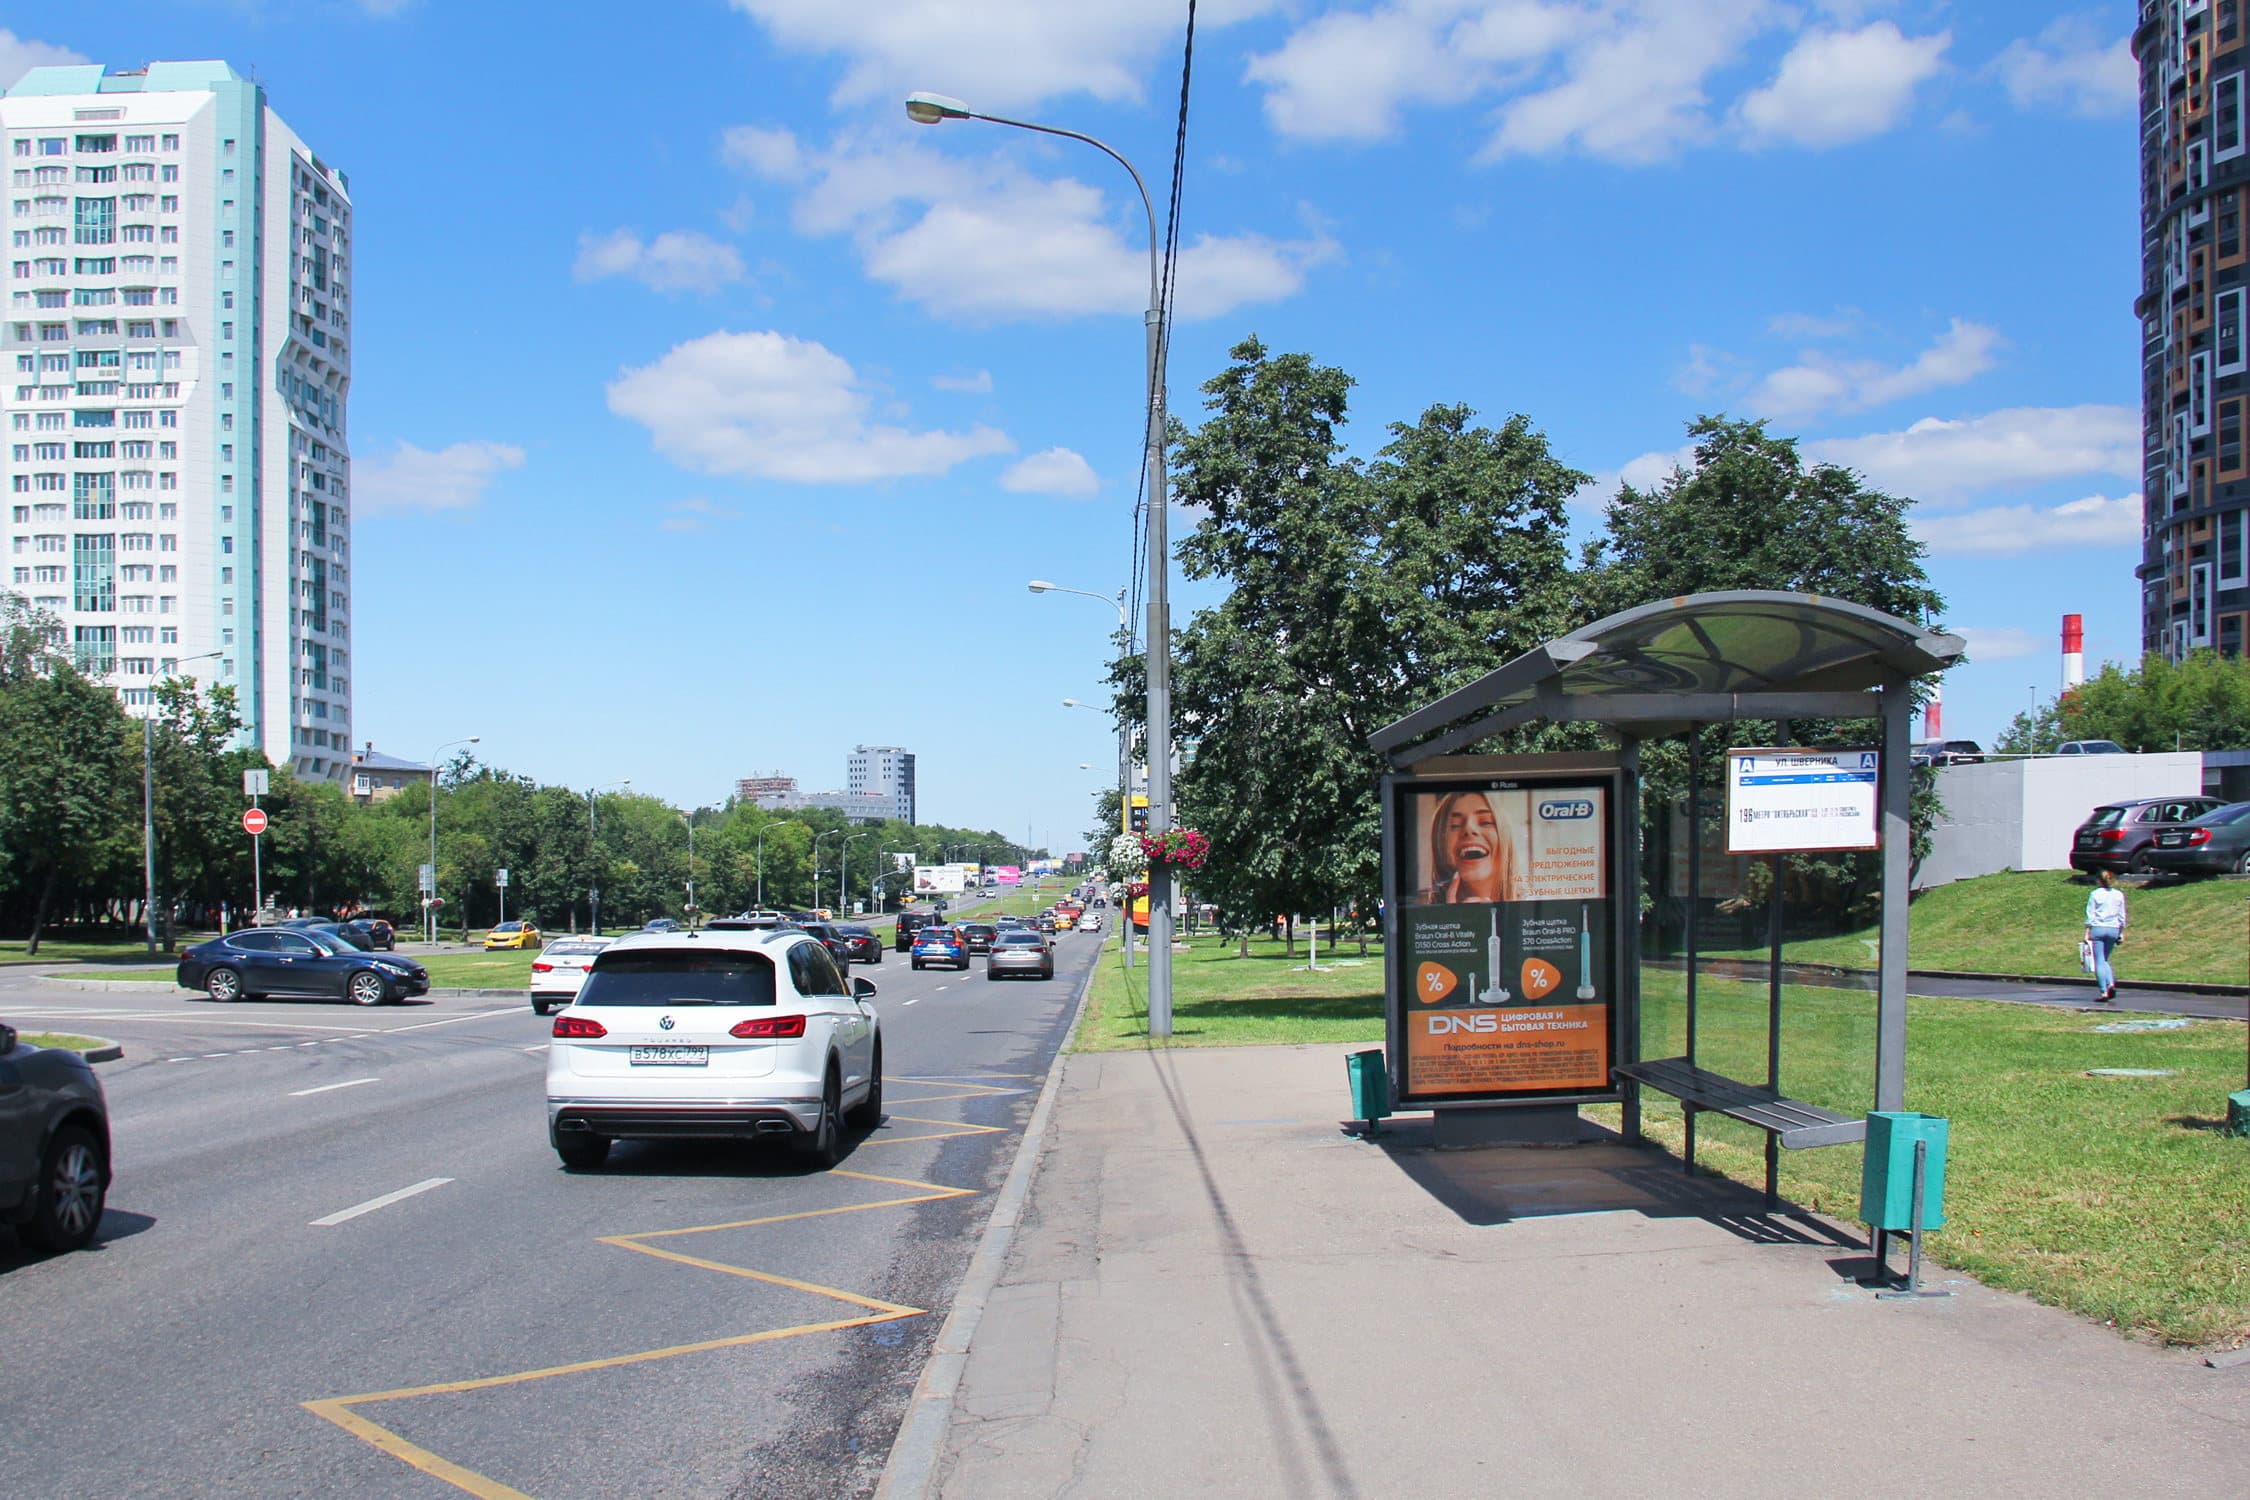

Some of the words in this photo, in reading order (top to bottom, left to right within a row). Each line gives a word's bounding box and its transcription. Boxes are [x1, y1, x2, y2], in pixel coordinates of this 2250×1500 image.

[1790, 756, 1839, 768] ШВЕРНИКА
[1541, 803, 1590, 818] Oral-B
[1739, 808, 1753, 823] 196
[1545, 847, 1595, 856] ВЫГОДНЫЕ
[1528, 860, 1595, 870] ПРЕДЛОЖЕНИЯ
[1526, 873, 1595, 883] ЭЛЕКТРИЧЕСКИЕ
[1529, 887, 1562, 897] ЗУБНЫЕ
[1564, 887, 1595, 895] ЩЕТКИ
[1415, 922, 1438, 931] Зубная
[1522, 919, 1545, 928] Зубная
[1415, 932, 1434, 940] Braun
[1522, 927, 1541, 936] Braun
[1432, 940, 1450, 949] Cross
[1451, 940, 1471, 948] Action
[1501, 1012, 1554, 1022] ЦИФРОВАЯ
[1555, 1011, 1564, 1021] И
[1428, 1014, 1498, 1035] DNS
[1501, 1022, 1545, 1033] БЫТОВАЯ
[1546, 1020, 1588, 1031] ТЕХНИКА
[1443, 1041, 1502, 1052] Подробности
[1516, 1039, 1566, 1050] dns-shop.ru
